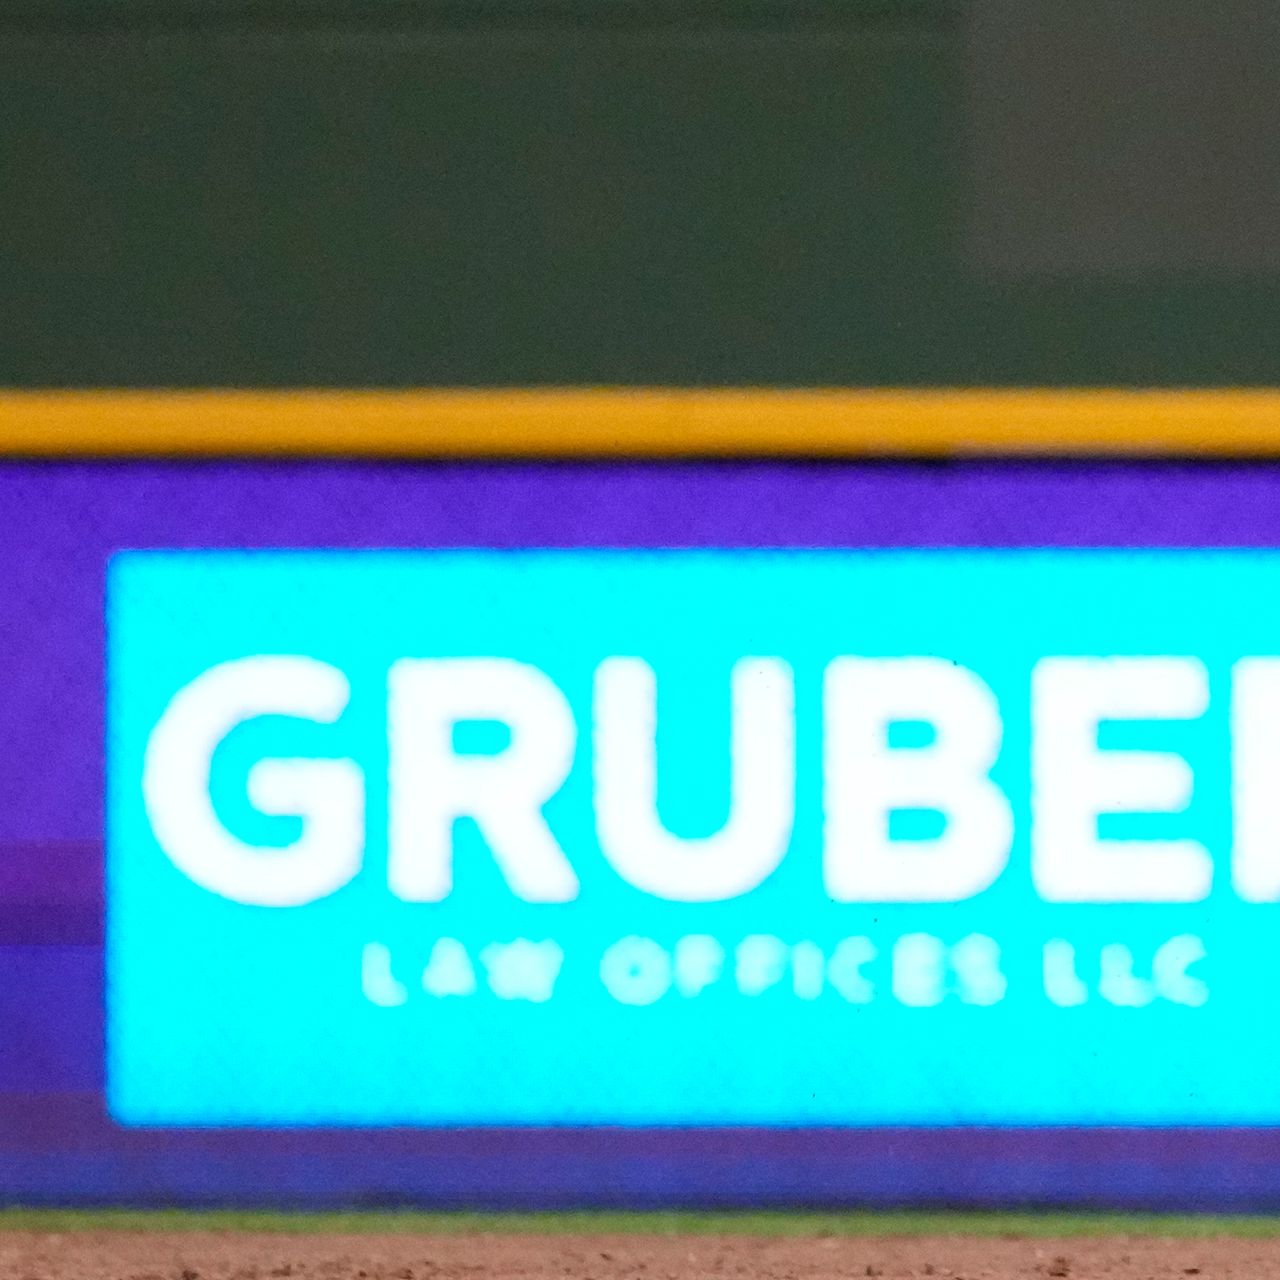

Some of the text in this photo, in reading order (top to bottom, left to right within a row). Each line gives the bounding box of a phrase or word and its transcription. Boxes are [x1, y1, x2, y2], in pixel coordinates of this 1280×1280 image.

[361, 932, 1209, 1008] LAW OFFICES LLC
